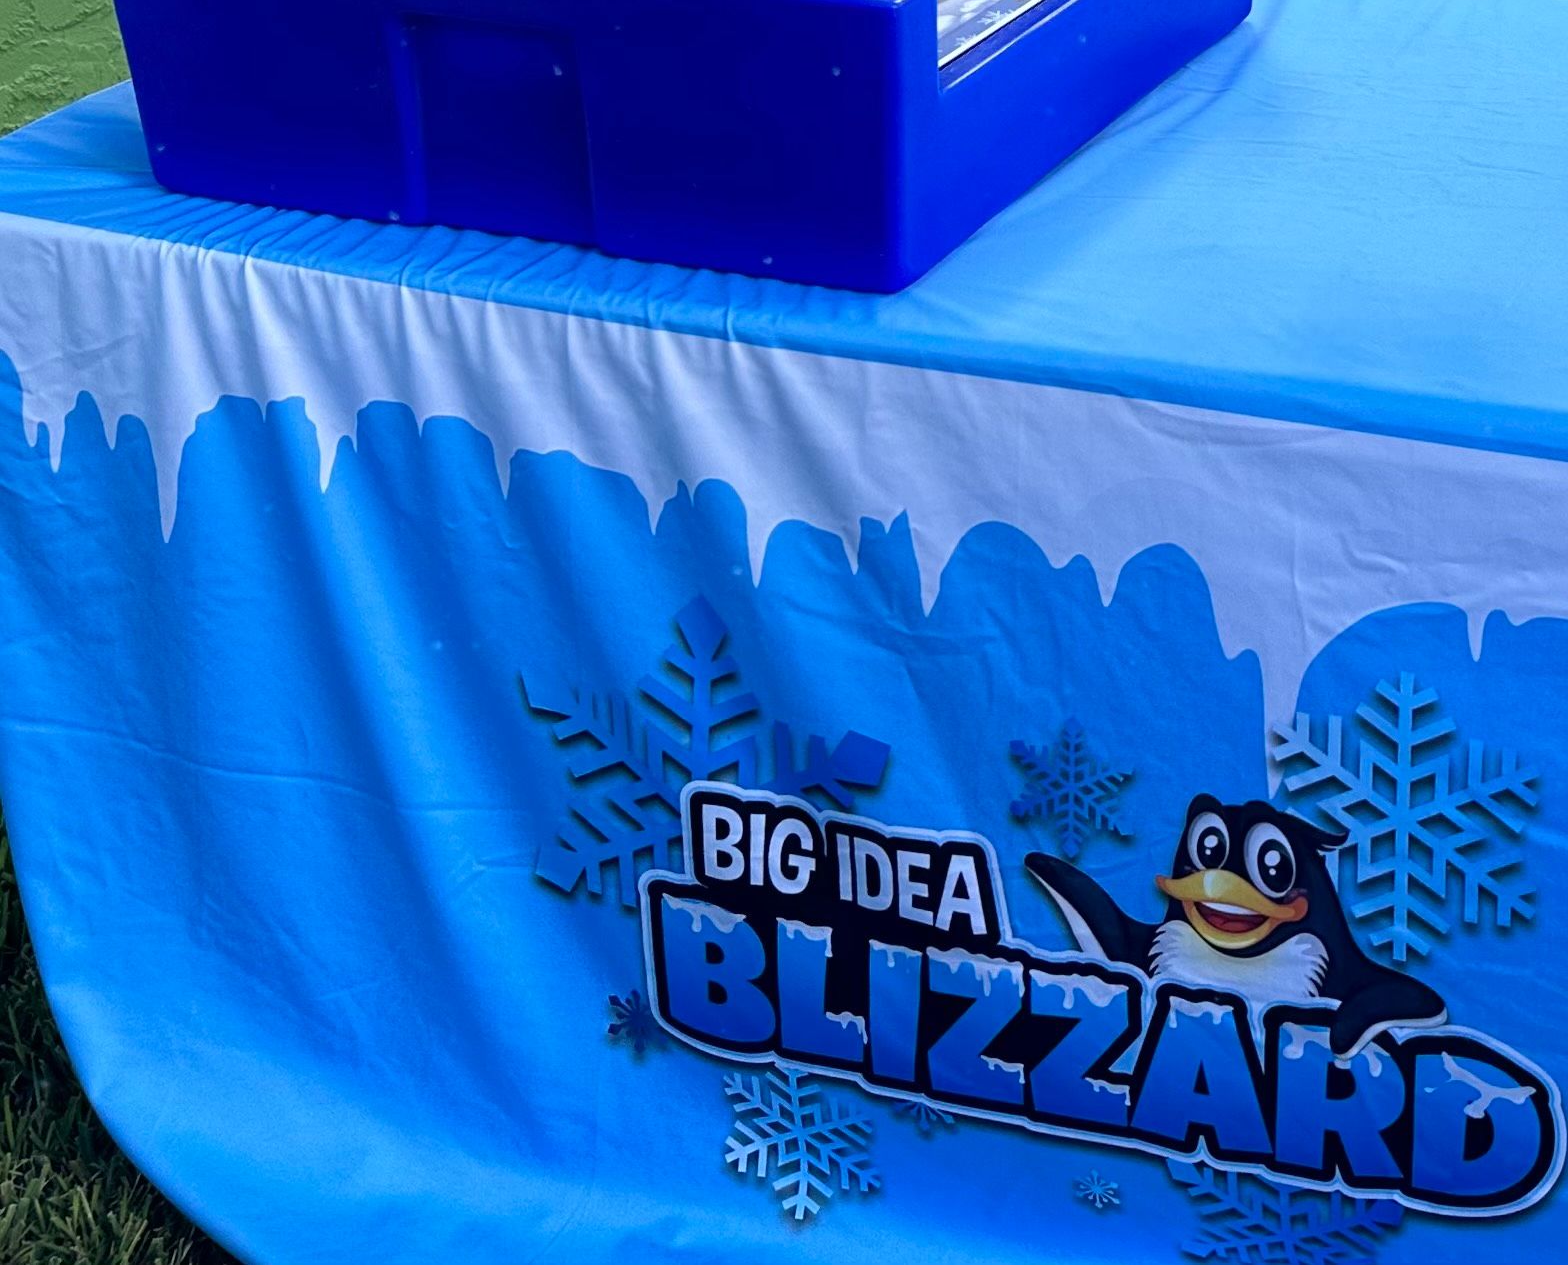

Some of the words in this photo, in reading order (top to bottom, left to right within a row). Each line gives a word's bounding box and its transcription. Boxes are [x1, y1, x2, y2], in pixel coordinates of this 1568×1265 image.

[699, 801, 817, 896] BIG
[835, 831, 988, 935] IDEA
[661, 893, 1545, 1200] BLIZZARD
